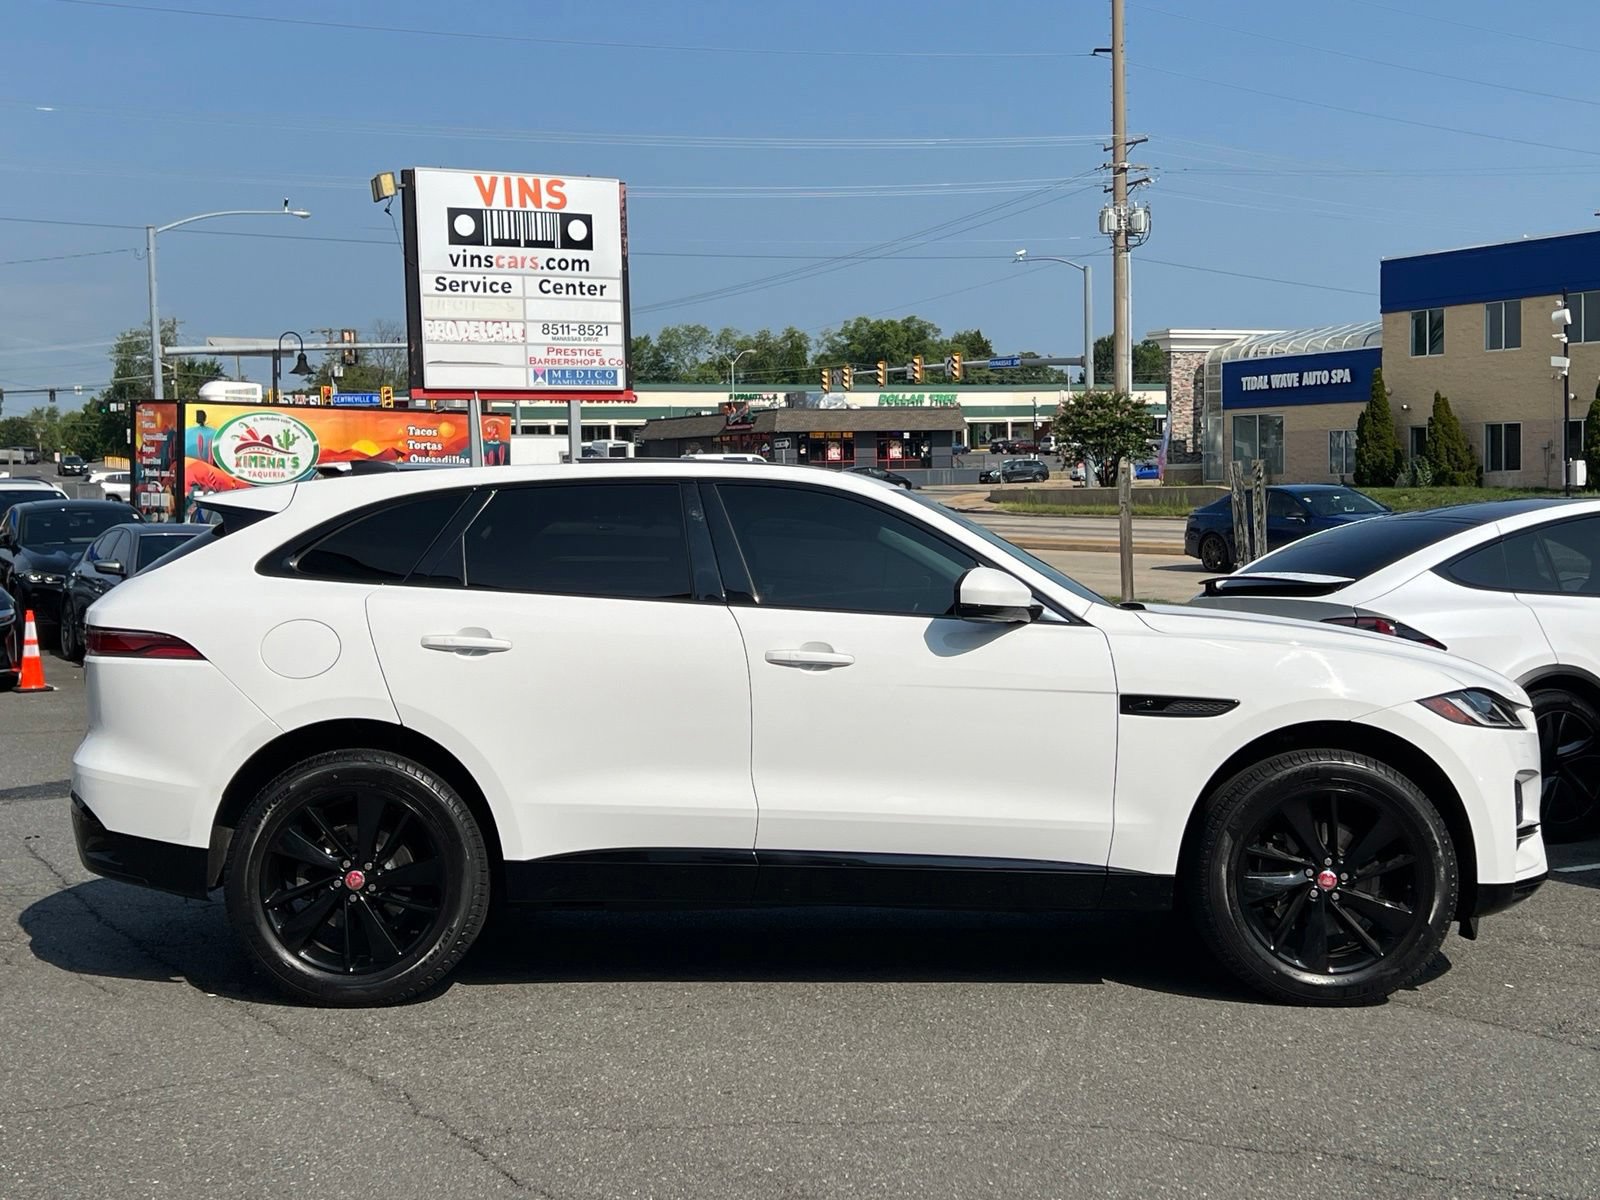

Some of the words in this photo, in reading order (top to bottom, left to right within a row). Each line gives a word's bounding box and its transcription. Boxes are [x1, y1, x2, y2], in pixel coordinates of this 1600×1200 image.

[473, 175, 568, 210] VINS
[448, 249, 590, 272] vinscars.com
[434, 276, 512, 294] Service
[538, 279, 607, 296] Center
[541, 323, 609, 336] 8511-8521
[546, 346, 603, 357] PRESTIGE
[529, 357, 597, 366] BARBERSHOP
[598, 358, 606, 366] &
[552, 370, 615, 379] MEDICO
[1241, 375, 1269, 391] TIDAL
[1270, 373, 1299, 388] WAVE
[1302, 370, 1329, 386] AUTO
[1330, 368, 1351, 384] SPA
[878, 394, 925, 405] DOLLAR
[407, 426, 438, 436] Tacos
[407, 440, 443, 450] Tortas
[234, 455, 300, 469] XIMENA'S
